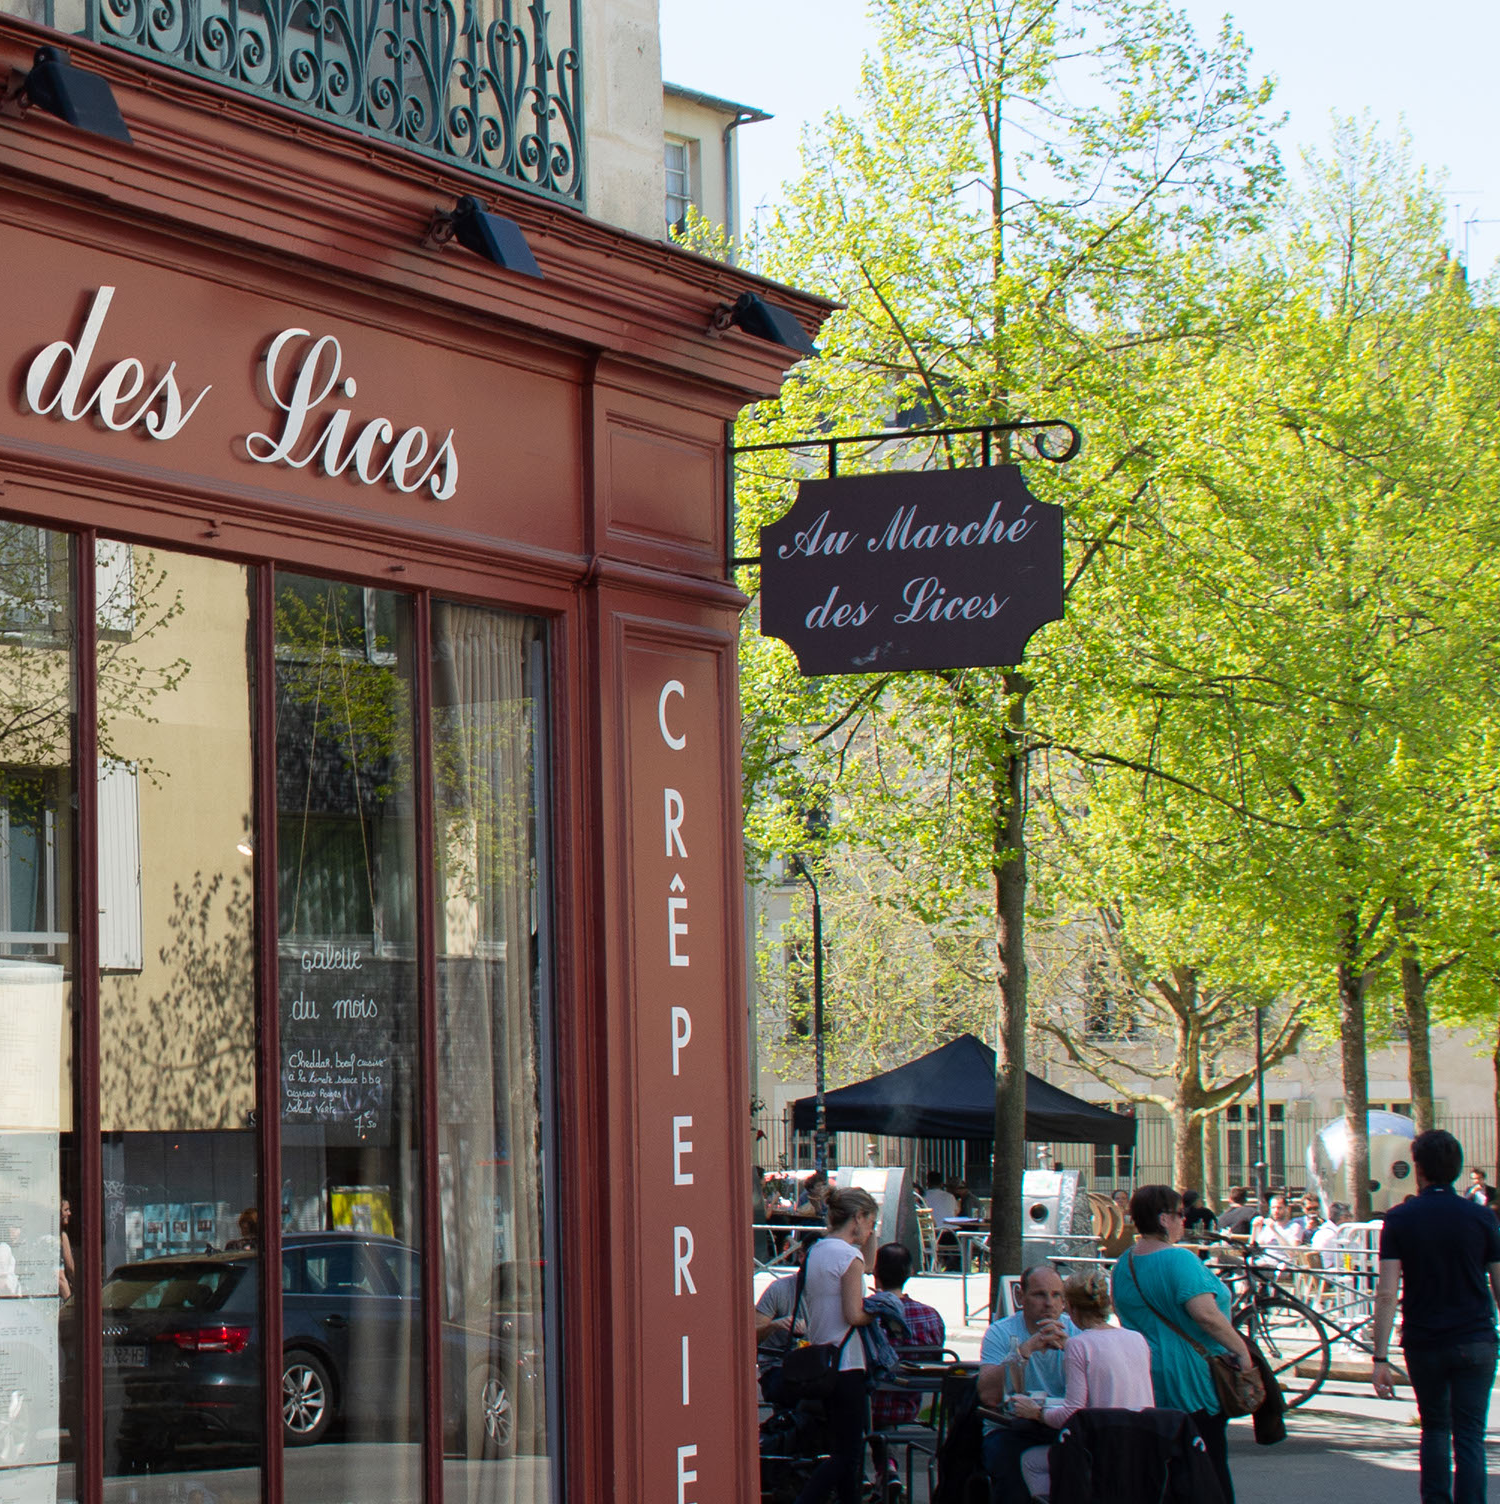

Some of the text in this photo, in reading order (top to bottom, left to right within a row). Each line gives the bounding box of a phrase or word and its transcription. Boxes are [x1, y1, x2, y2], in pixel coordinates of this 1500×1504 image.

[26, 287, 211, 441] des
[246, 327, 460, 501] Lices
[778, 502, 1038, 559] Au Marché
[805, 576, 1009, 629] des Lices
[302, 946, 362, 972] Galette
[289, 991, 378, 1020] du mois
